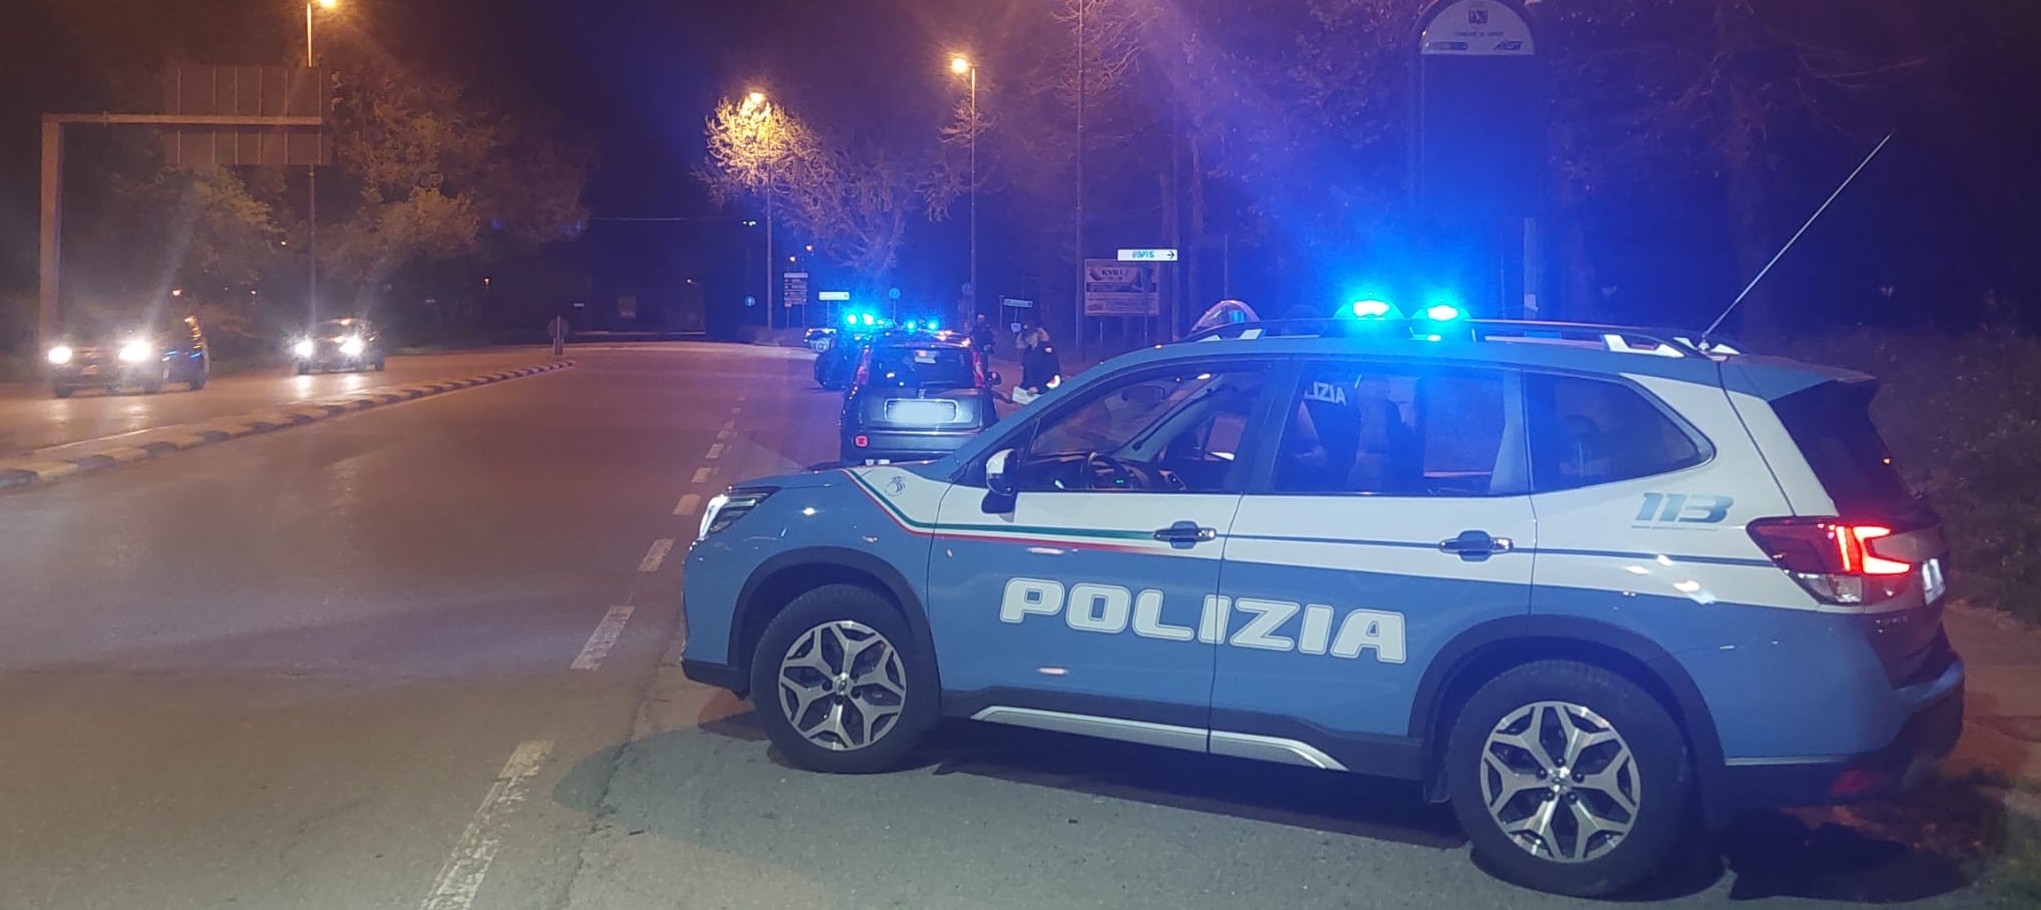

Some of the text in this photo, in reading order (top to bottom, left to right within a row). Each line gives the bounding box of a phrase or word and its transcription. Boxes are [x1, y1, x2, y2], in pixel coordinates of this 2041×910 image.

[1304, 381, 1347, 406] LIZIA
[1635, 492, 1734, 523] 113
[1000, 577, 1407, 664] POLIZIA
